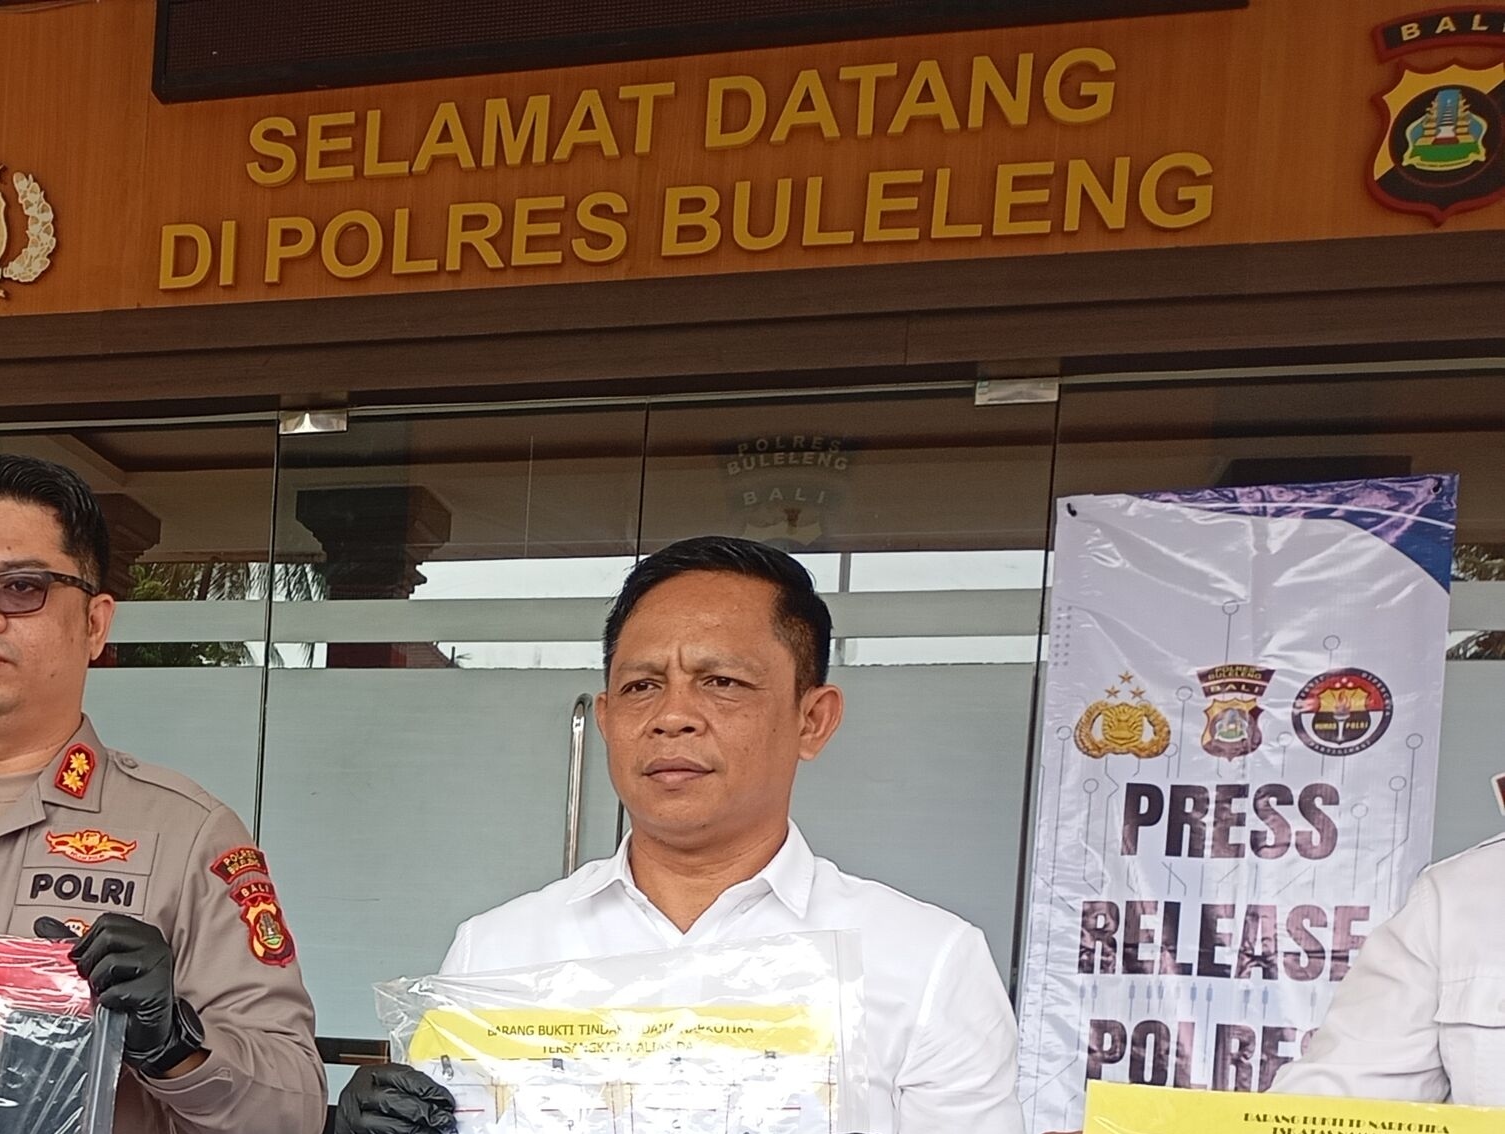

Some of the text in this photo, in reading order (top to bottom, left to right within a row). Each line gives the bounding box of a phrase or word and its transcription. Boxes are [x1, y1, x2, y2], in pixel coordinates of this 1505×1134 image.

[1401, 14, 1505, 41] BAL
[246, 47, 1117, 188] SELAMAT DATANG
[158, 151, 1214, 292] DI POLRES BULELENG
[738, 436, 842, 457] POLRES
[727, 452, 848, 475] BULELENG
[743, 487, 825, 505] BALI
[1210, 684, 1259, 693] BALI
[1121, 782, 1340, 860] PRESS
[30, 873, 135, 907] POLRI
[1077, 901, 1371, 982] RELEASE
[538, 1024, 574, 1036] BUKTI
[1087, 1018, 1320, 1093] POLRE
